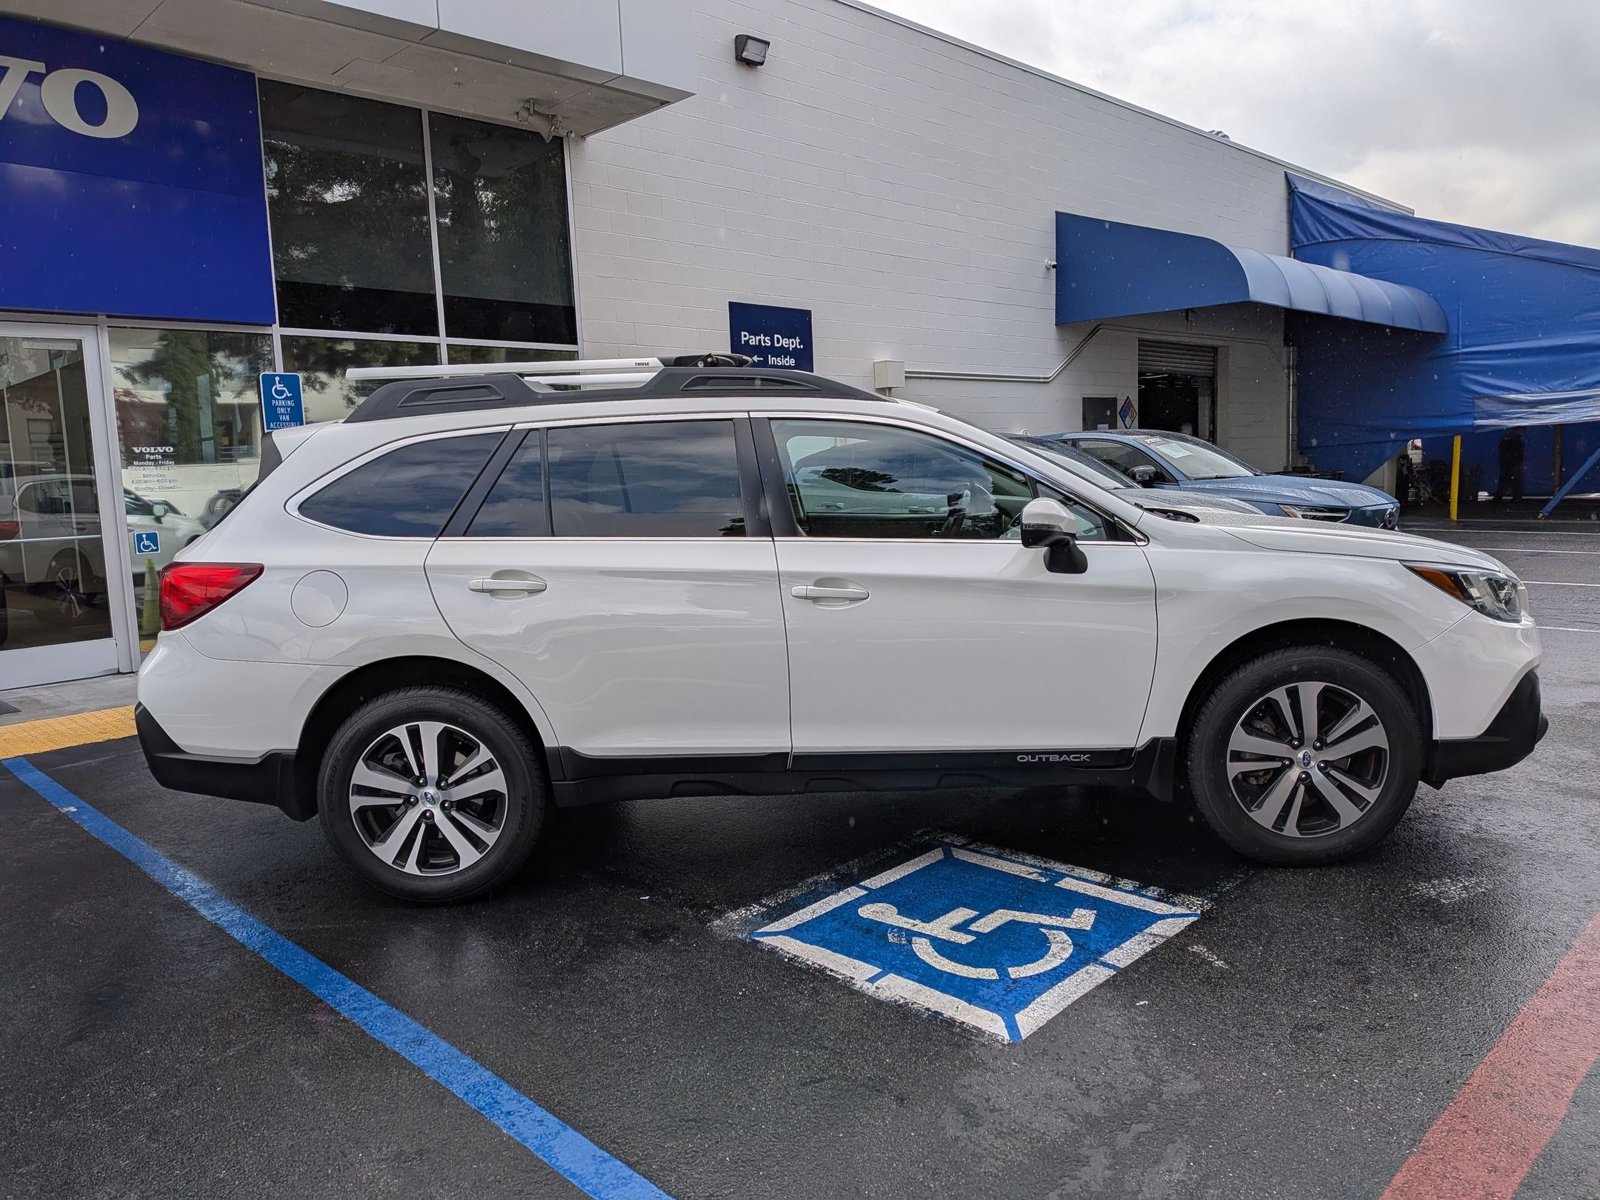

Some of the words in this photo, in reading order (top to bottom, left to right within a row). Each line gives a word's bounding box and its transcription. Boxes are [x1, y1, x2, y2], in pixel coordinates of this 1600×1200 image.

[741, 331, 771, 347] Parts
[774, 334, 804, 351] Dept.
[768, 354, 796, 366] Inside
[1016, 754, 1091, 762] OUTBACK
